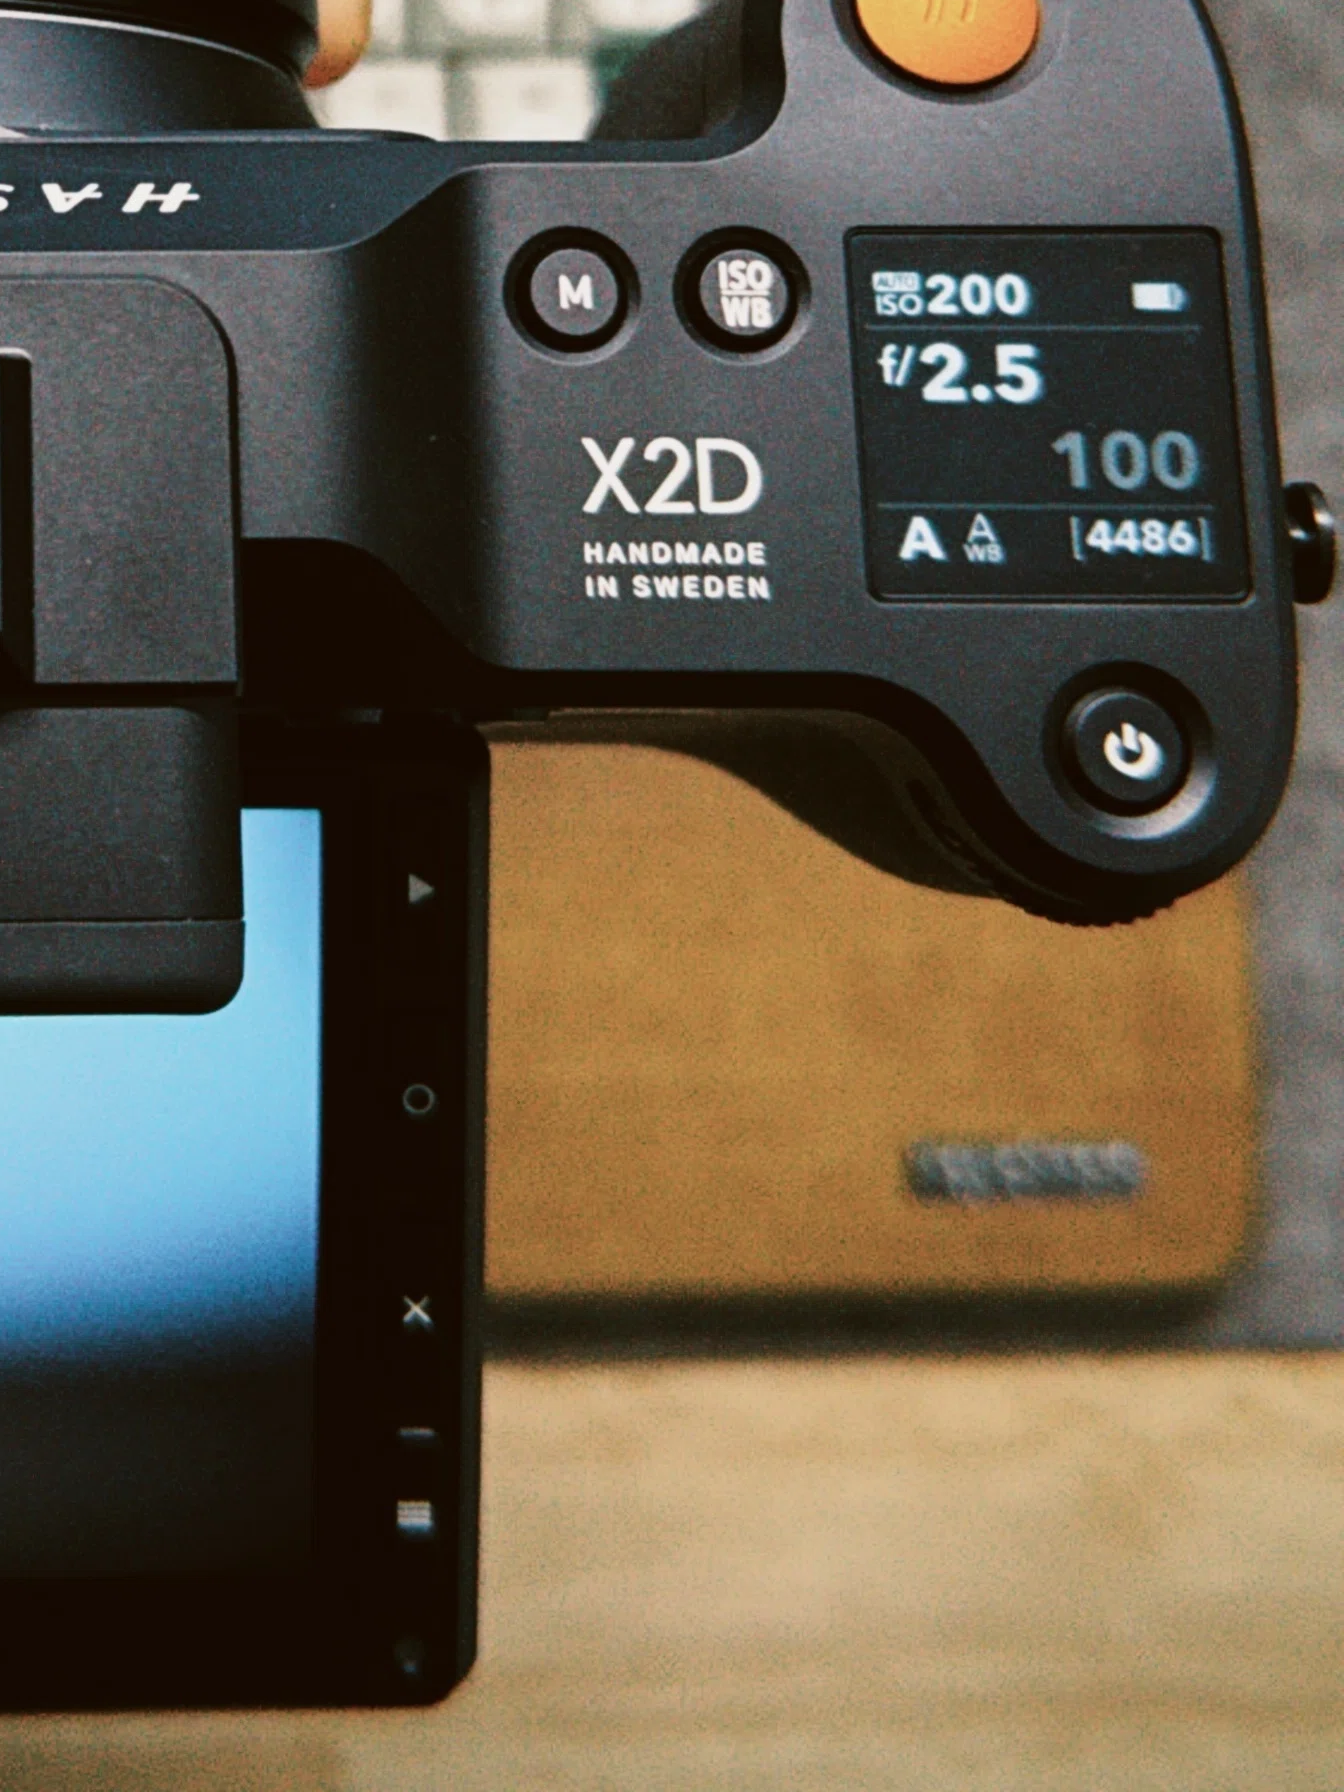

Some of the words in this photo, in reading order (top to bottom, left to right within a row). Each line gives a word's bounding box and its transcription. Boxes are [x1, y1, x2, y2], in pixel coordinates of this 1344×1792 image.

[558, 274, 594, 311] M
[718, 260, 774, 293] ISO
[925, 272, 1028, 316] 200
[721, 296, 774, 330] WB
[877, 342, 1044, 403] f/2.5
[581, 437, 764, 515] X2D
[1052, 430, 1198, 490] 100
[583, 541, 767, 566] HANDMADE
[899, 515, 947, 561] A
[584, 575, 619, 599] IN
[632, 575, 771, 600] SWEDEN
